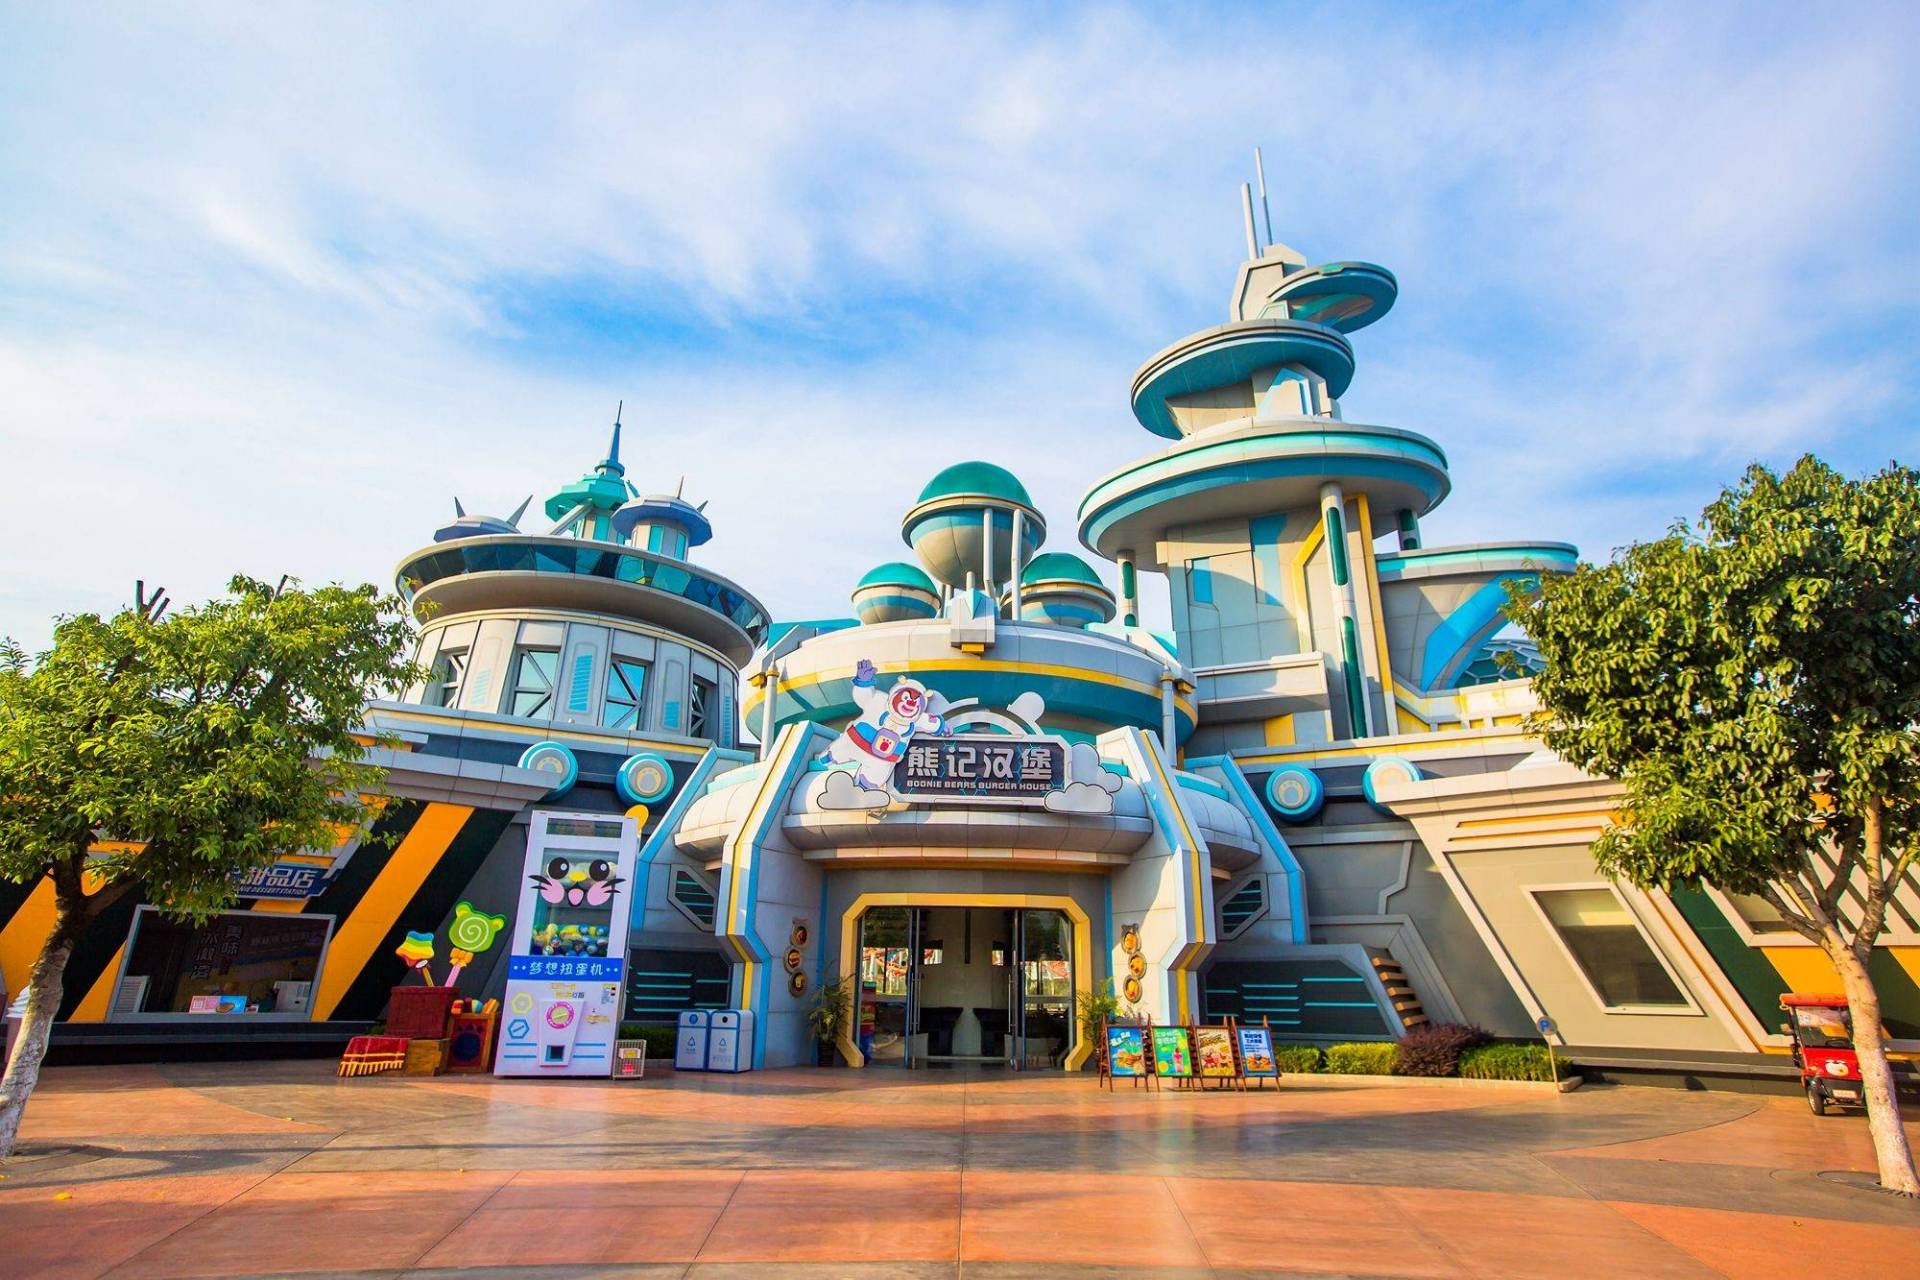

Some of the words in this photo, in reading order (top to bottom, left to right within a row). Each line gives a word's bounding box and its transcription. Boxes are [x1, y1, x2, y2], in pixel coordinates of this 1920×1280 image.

[907, 746, 1052, 780] 熊记汉堡
[907, 780, 942, 788] BOONIE
[944, 781, 977, 789] BEARS
[978, 782, 1017, 790] BURGER
[233, 865, 318, 888] 甜品店
[528, 961, 604, 976] 梦想扭蛋机
